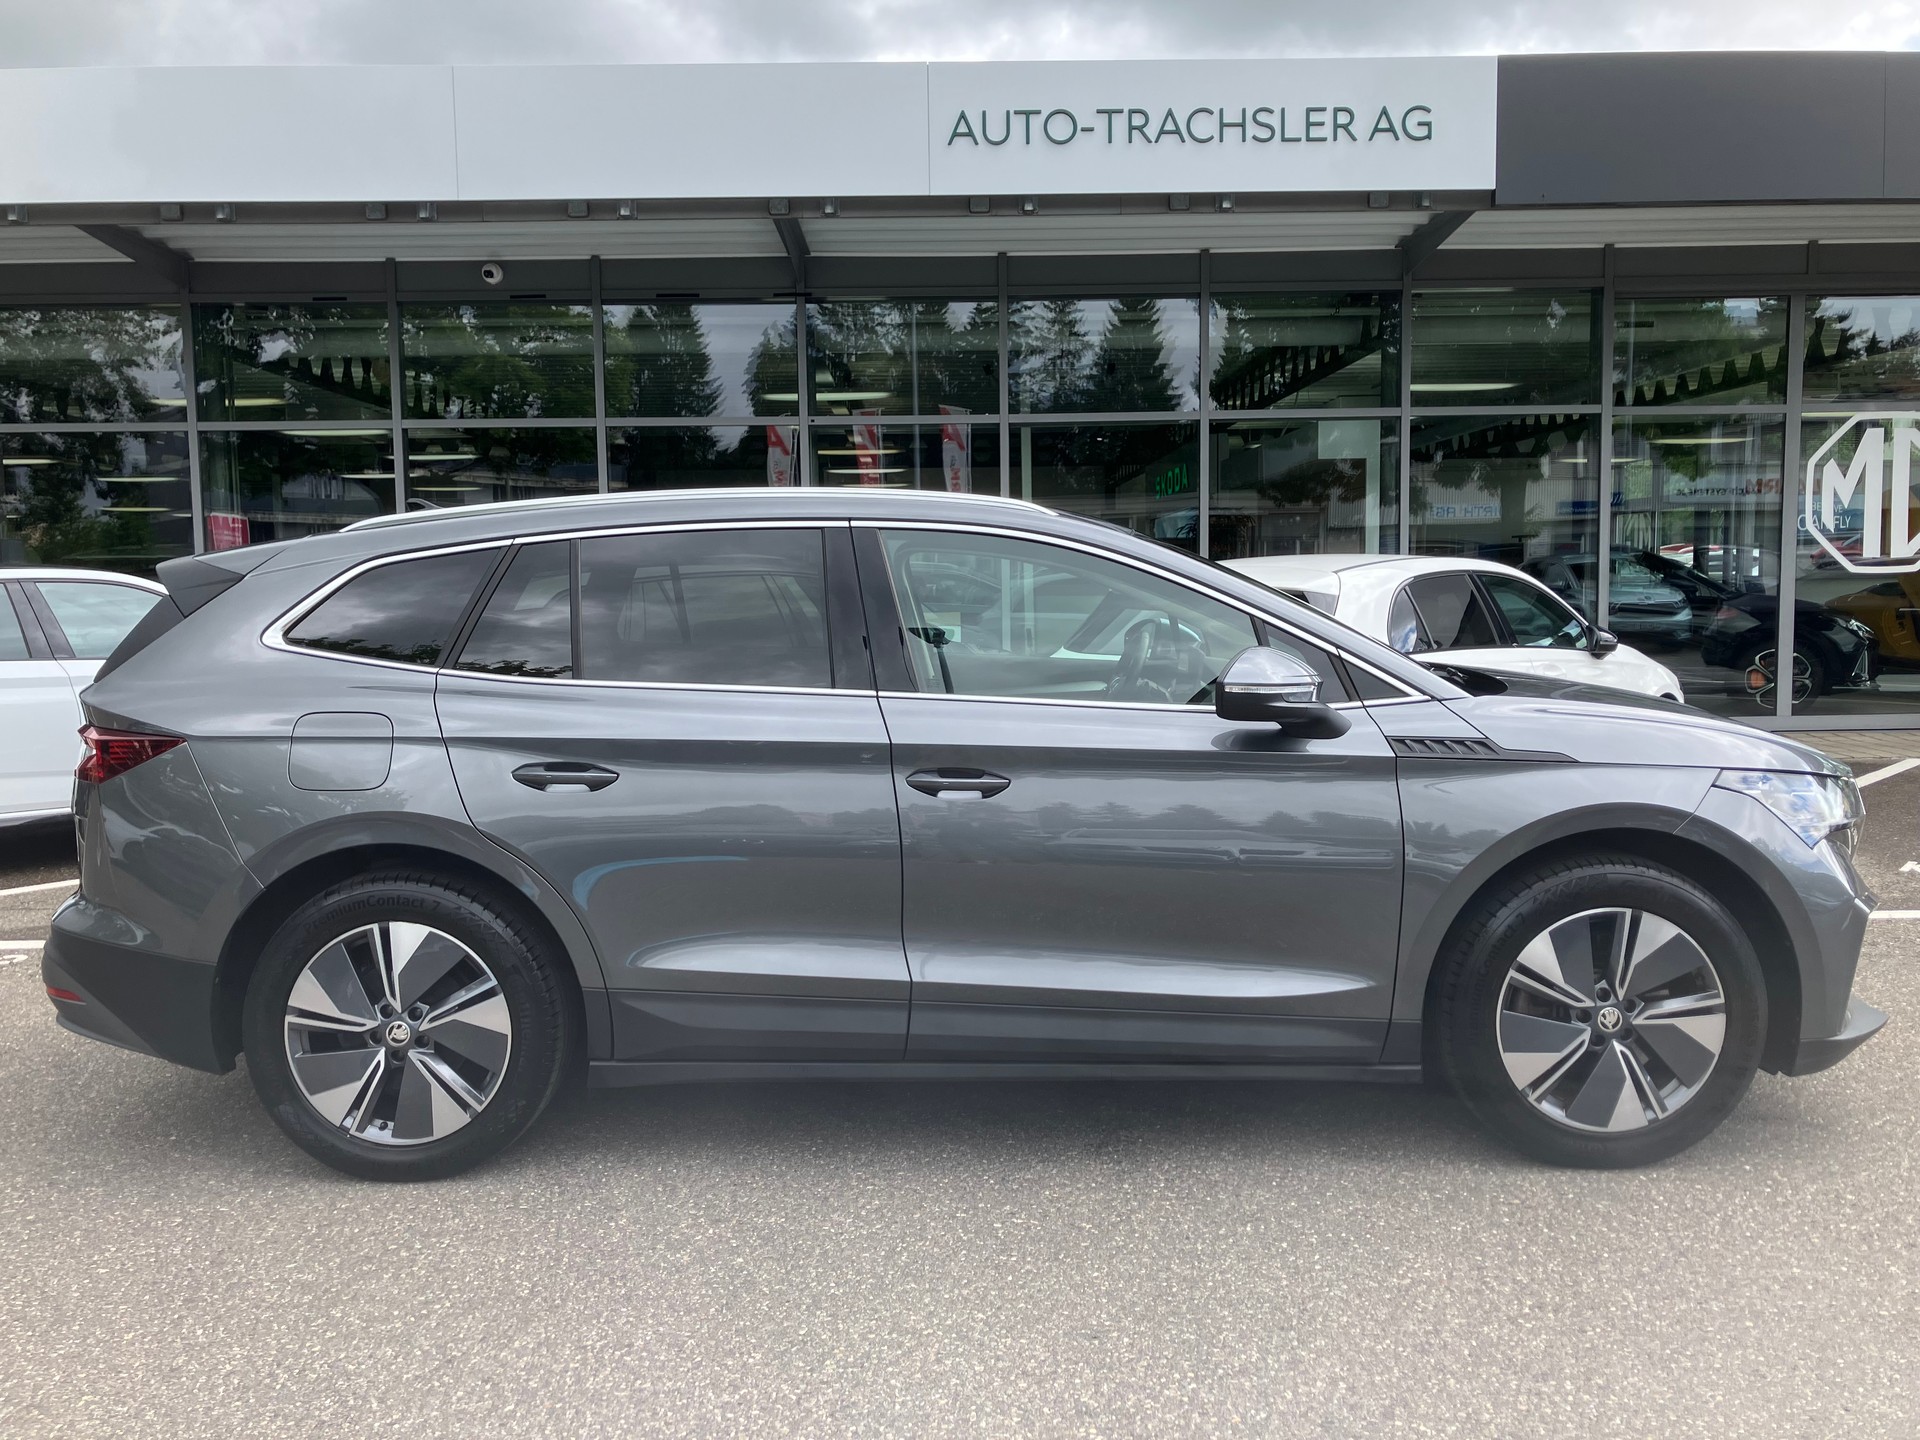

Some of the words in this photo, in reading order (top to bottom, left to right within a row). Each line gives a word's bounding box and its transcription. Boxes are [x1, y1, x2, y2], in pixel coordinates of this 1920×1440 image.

[947, 104, 1358, 147] AUTO-TRACHSLER
[1368, 104, 1434, 142] AG
[1834, 515, 1852, 529] FLY
[302, 894, 425, 933] PremiumContact
[430, 900, 441, 911] 7
